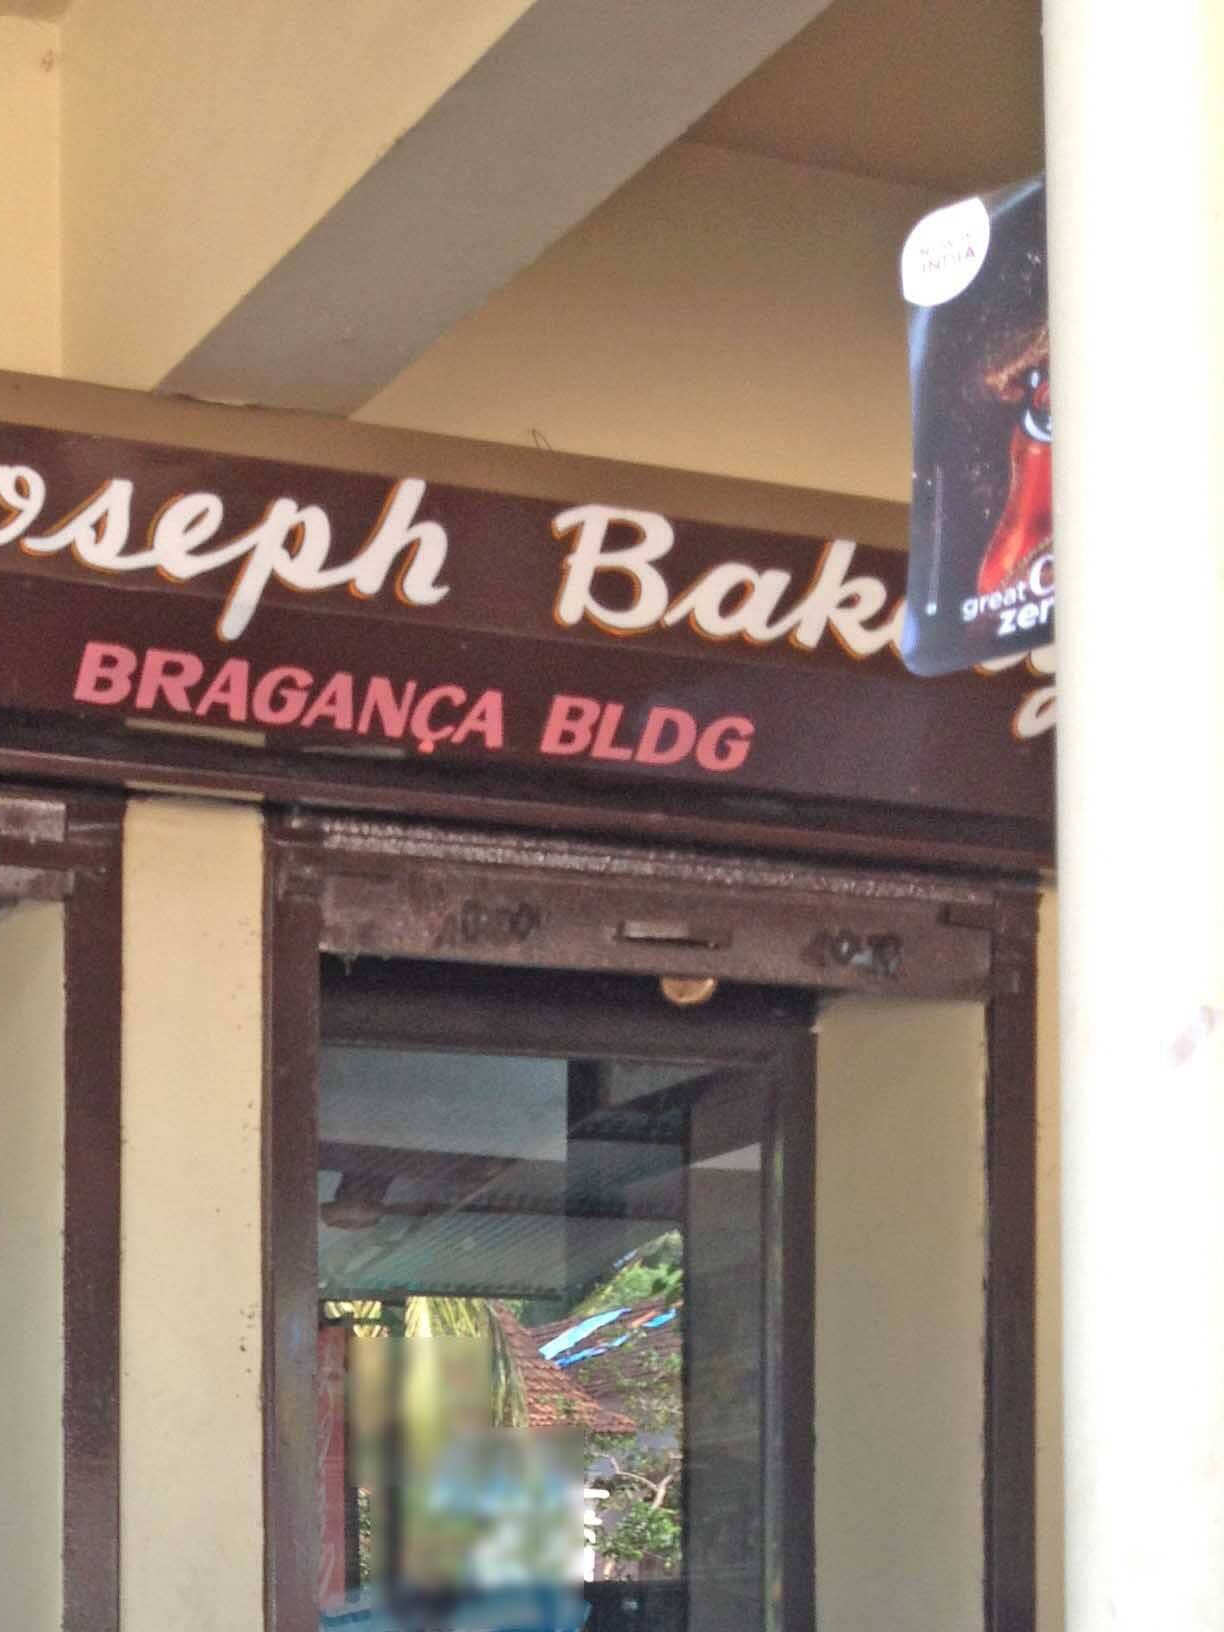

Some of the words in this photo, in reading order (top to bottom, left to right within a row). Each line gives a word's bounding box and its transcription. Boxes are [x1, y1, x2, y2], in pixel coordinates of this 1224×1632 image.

[962, 580, 1027, 622] great
[74, 641, 505, 753] BRAGANÇA
[540, 694, 755, 773] BLDG
